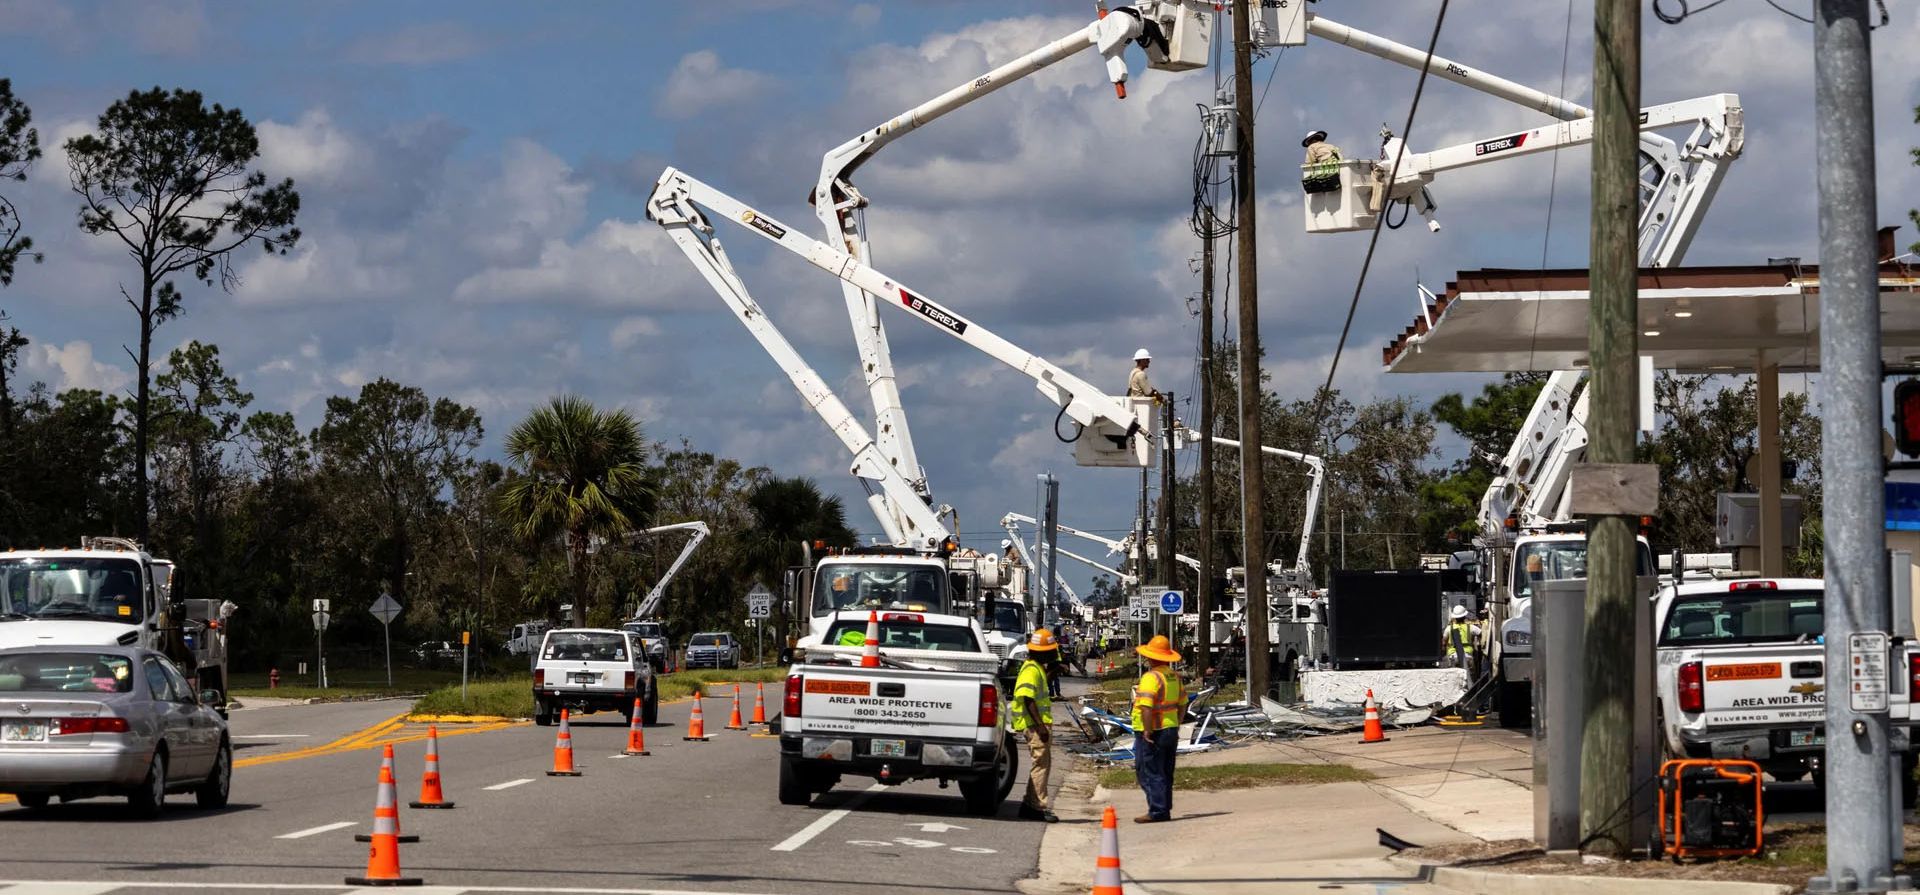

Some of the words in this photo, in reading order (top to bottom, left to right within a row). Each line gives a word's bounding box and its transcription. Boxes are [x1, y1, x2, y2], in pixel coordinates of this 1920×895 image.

[1261, 0, 1288, 9] Altec
[1446, 63, 1468, 78] Altec
[1485, 139, 1512, 152] TEREX
[924, 305, 959, 331] TEREX
[751, 605, 768, 615] 45
[1131, 609, 1148, 619] 45
[829, 696, 856, 704] AREA
[859, 698, 885, 706] WIDE
[888, 700, 952, 710] PROTECTIVE
[1732, 698, 1764, 708] AREA
[1768, 696, 1798, 705] WIDE
[854, 708, 878, 716] (800)
[880, 709, 926, 719] 343-2650
